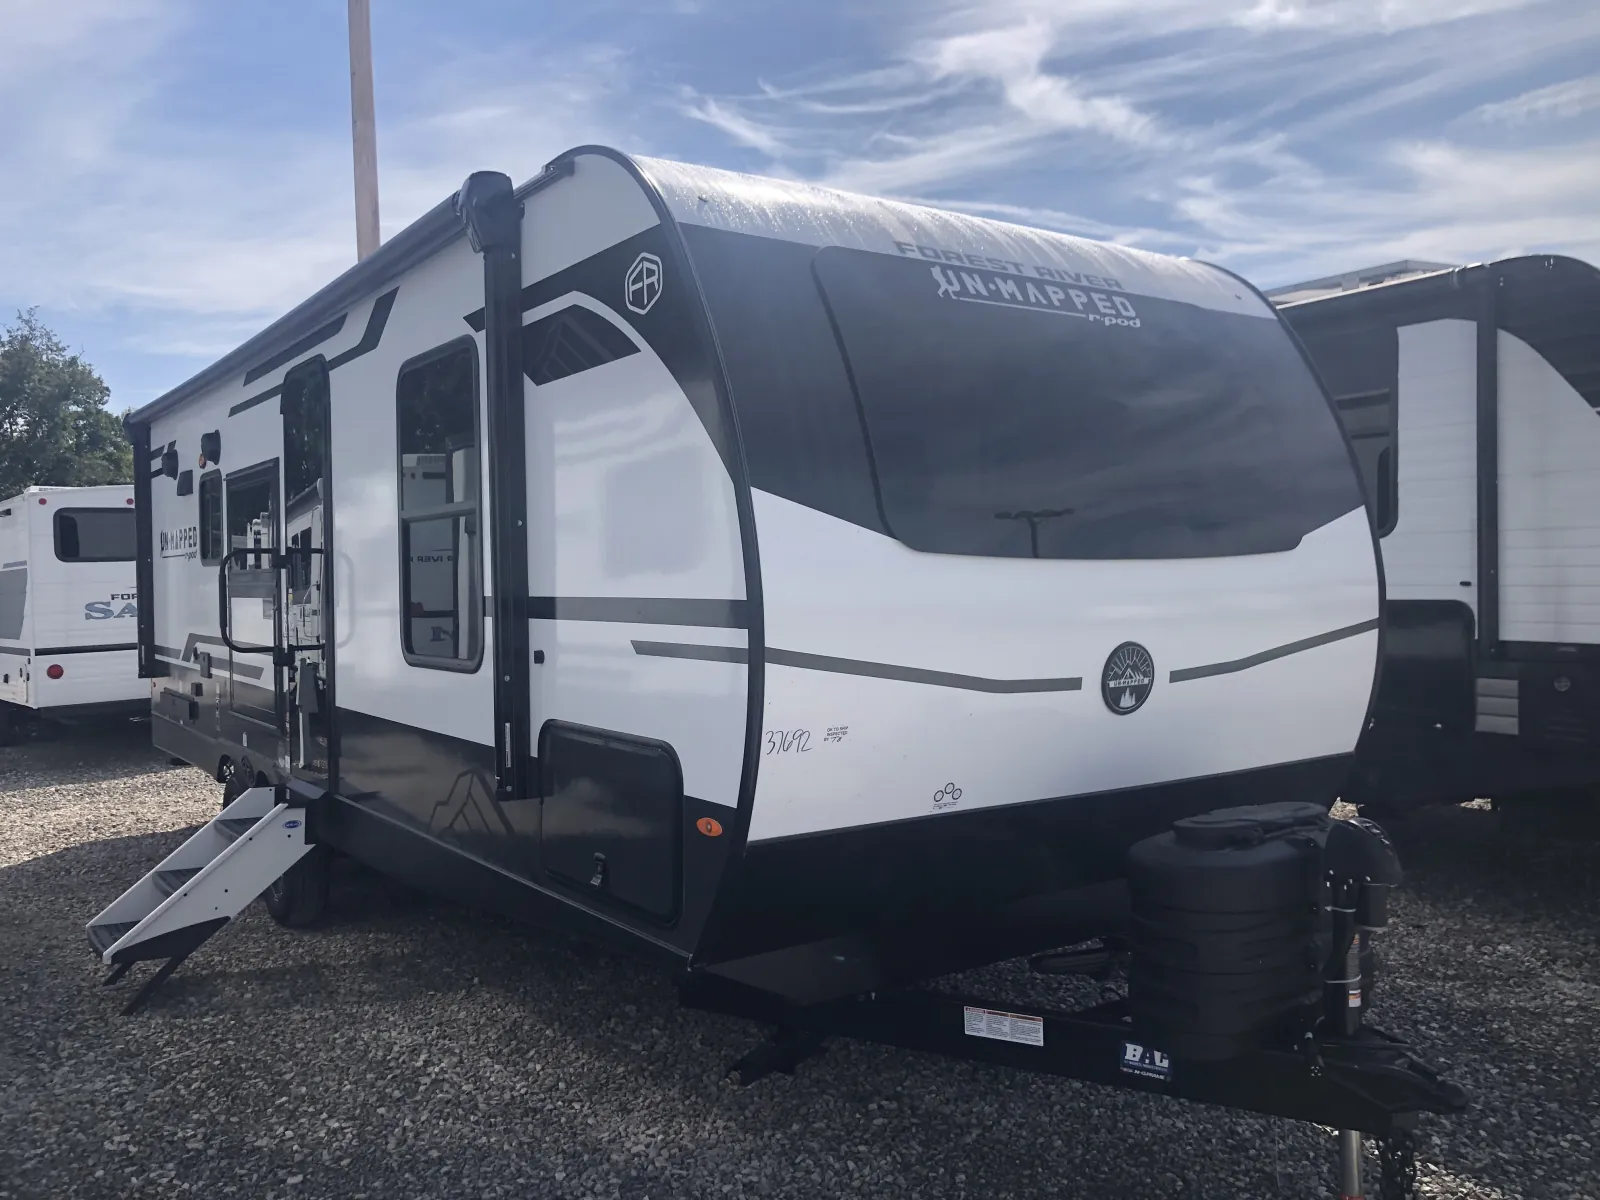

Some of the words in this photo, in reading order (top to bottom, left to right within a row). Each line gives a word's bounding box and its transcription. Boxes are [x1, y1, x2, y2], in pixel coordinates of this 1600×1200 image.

[893, 241, 1023, 275] FOREST
[1032, 265, 1125, 292] RIVER
[85, 601, 137, 620] SA
[765, 729, 813, 756] 37692
